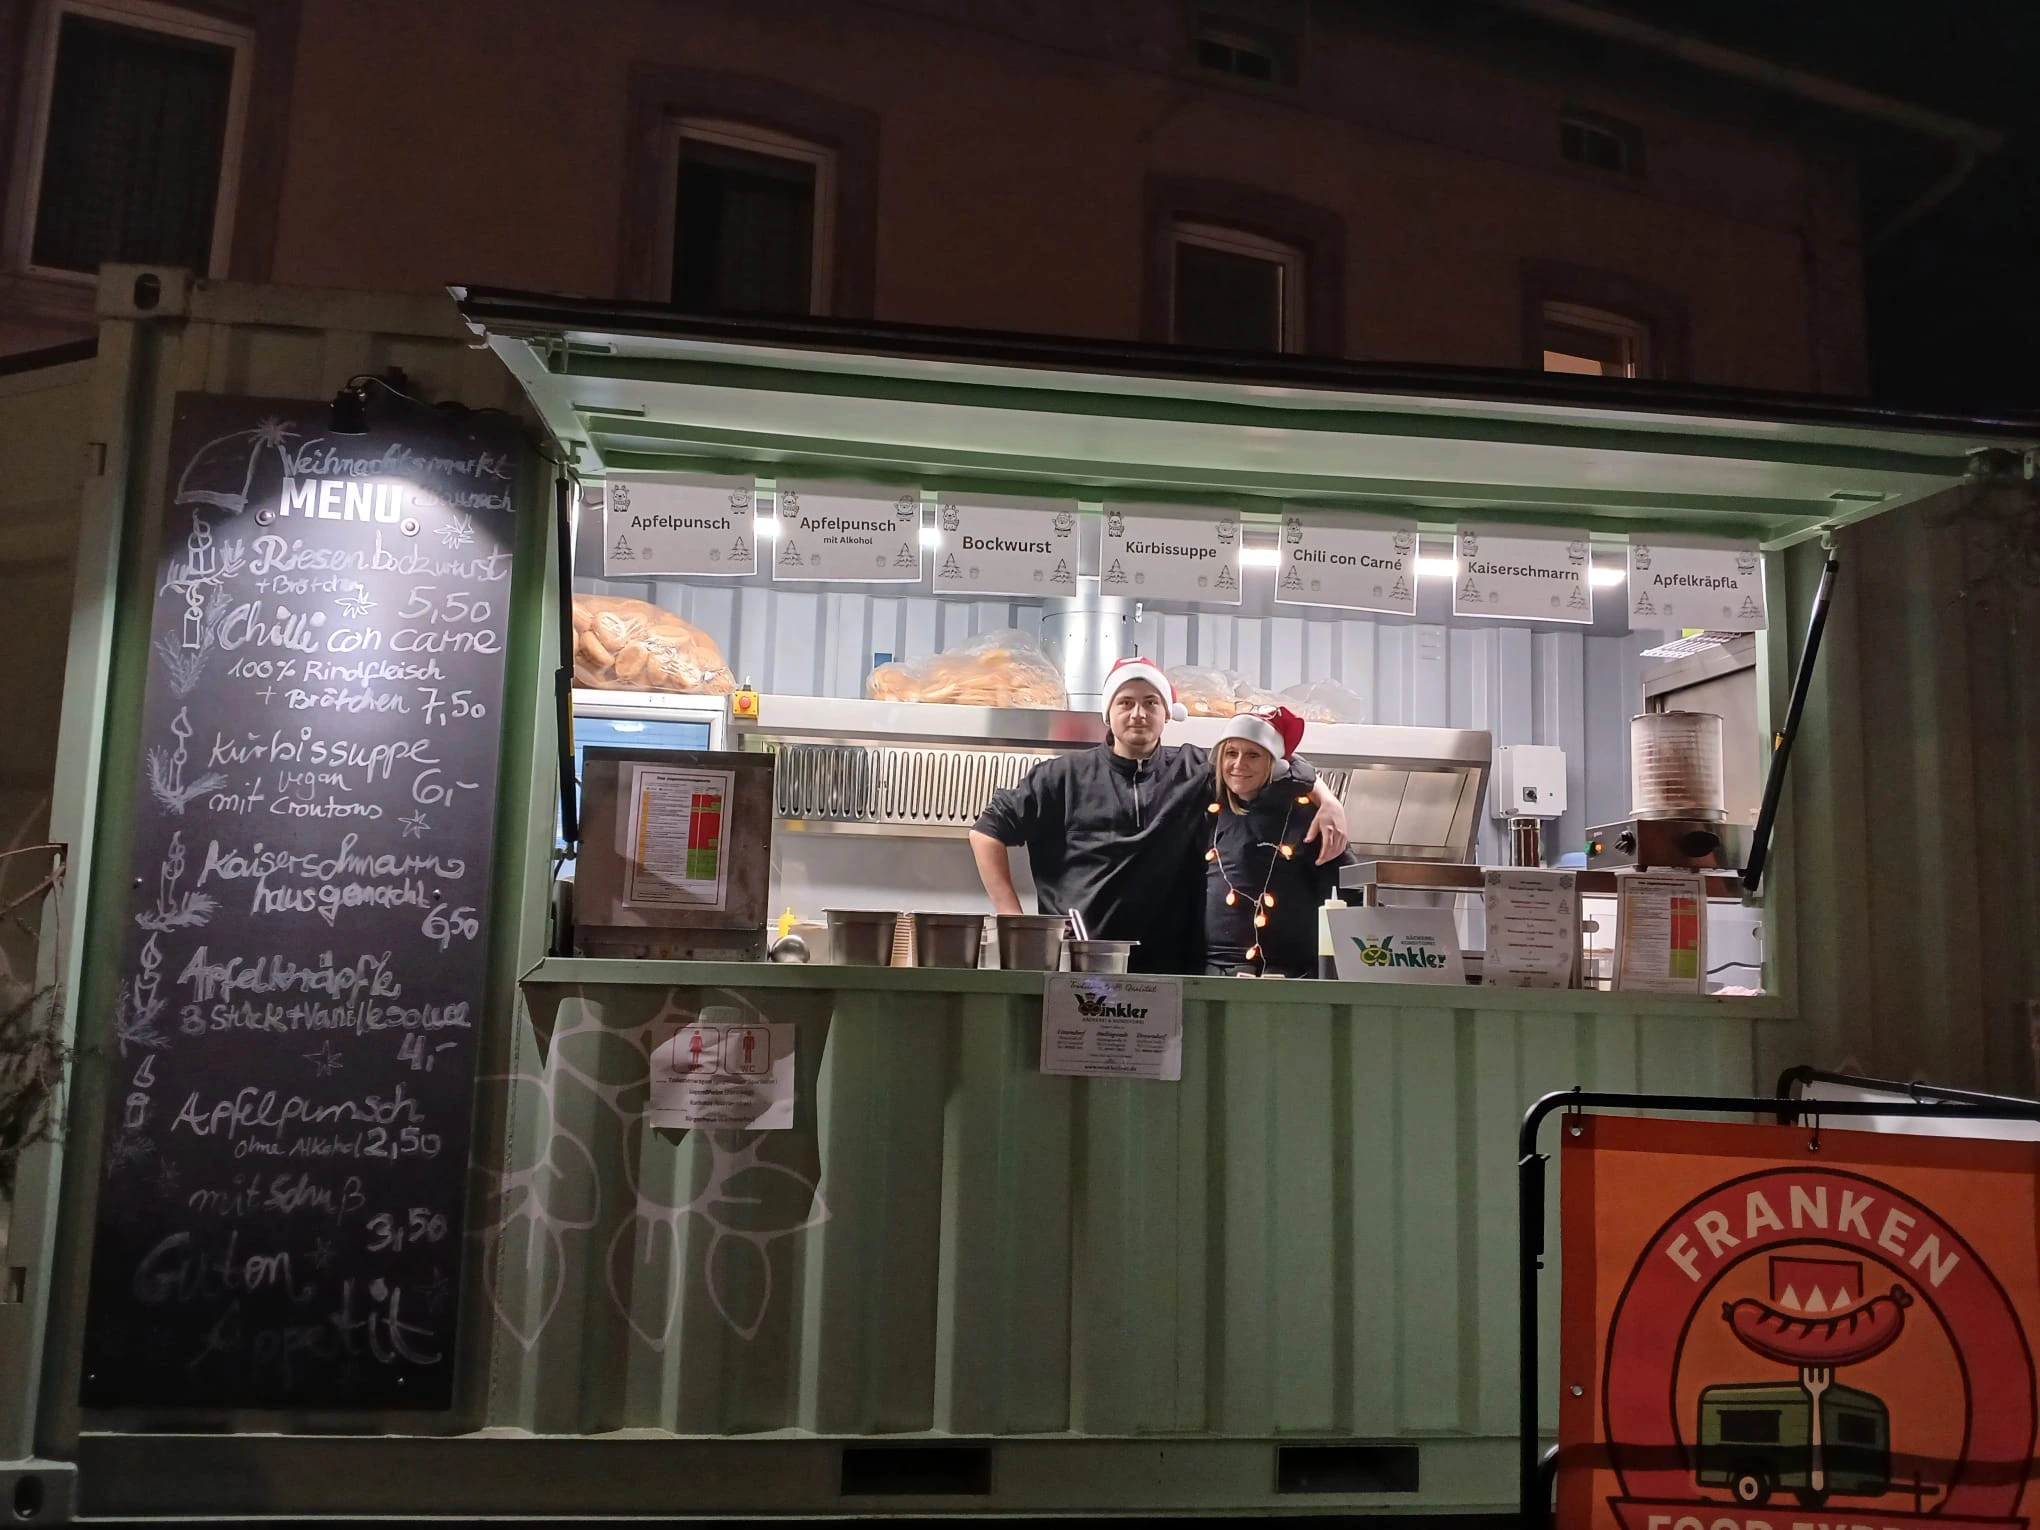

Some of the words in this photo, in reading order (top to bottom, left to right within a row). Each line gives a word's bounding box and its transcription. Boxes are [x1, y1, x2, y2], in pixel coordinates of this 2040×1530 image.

[279, 477, 402, 524] MENU
[630, 513, 732, 533] Apfelpunsch
[799, 515, 897, 533] Apfelpunsch
[823, 534, 838, 544] mit
[840, 535, 873, 545] Alkohol
[962, 534, 1053, 554] Bockwurst
[1125, 540, 1218, 561] Kürbissuppe
[1293, 549, 1326, 563] Chili
[1330, 554, 1356, 566] con
[1360, 555, 1402, 571] Carné
[1468, 561, 1579, 581] Kaiserschmarrn
[1653, 573, 1738, 591] Apfelkräpfla
[398, 586, 491, 625] 5,50
[326, 628, 382, 652] con
[228, 658, 296, 679] 100%
[303, 658, 446, 687] Rindfleisch
[285, 688, 411, 713] Brötchen
[417, 687, 487, 726] 7,50
[1351, 935, 1447, 969] Winkler
[1074, 993, 1149, 1019] Winkler
[741, 1064, 756, 1073] WC
[170, 1083, 425, 1141] Apfelpunsch
[363, 1126, 441, 1160] 2,50
[365, 1207, 448, 1252] 3,50
[1665, 1185, 1961, 1288] FRANKEN
